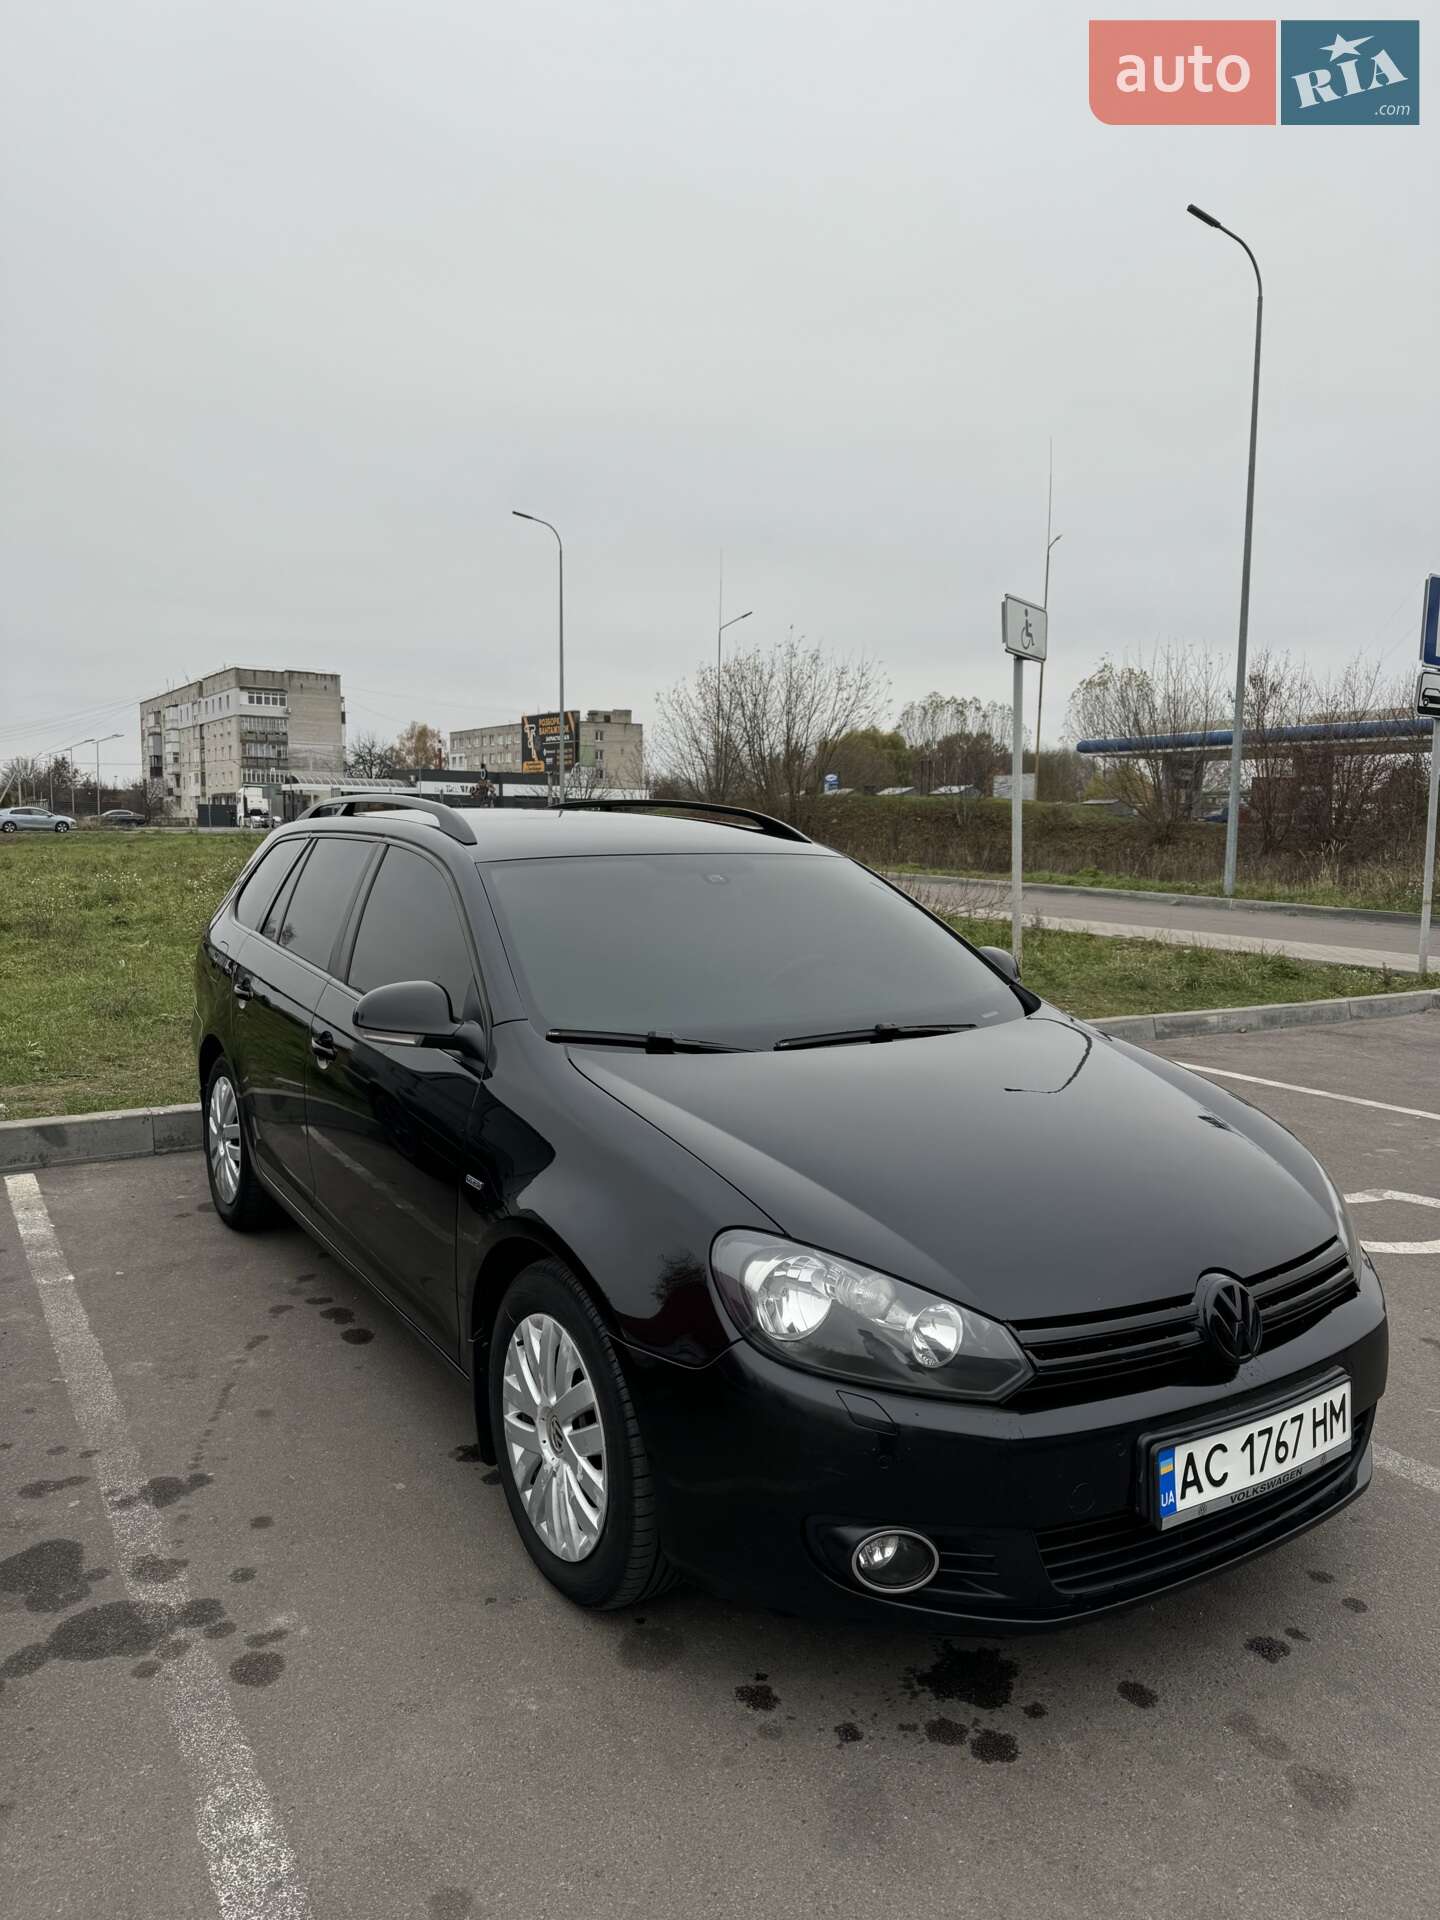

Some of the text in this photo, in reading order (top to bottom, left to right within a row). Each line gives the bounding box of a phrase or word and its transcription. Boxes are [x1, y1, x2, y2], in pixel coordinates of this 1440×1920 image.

[1180, 1393, 1347, 1500] AC 1767 HM
[1161, 1492, 1175, 1508] UA
[1230, 1468, 1304, 1504] VOLKSWAGEN
